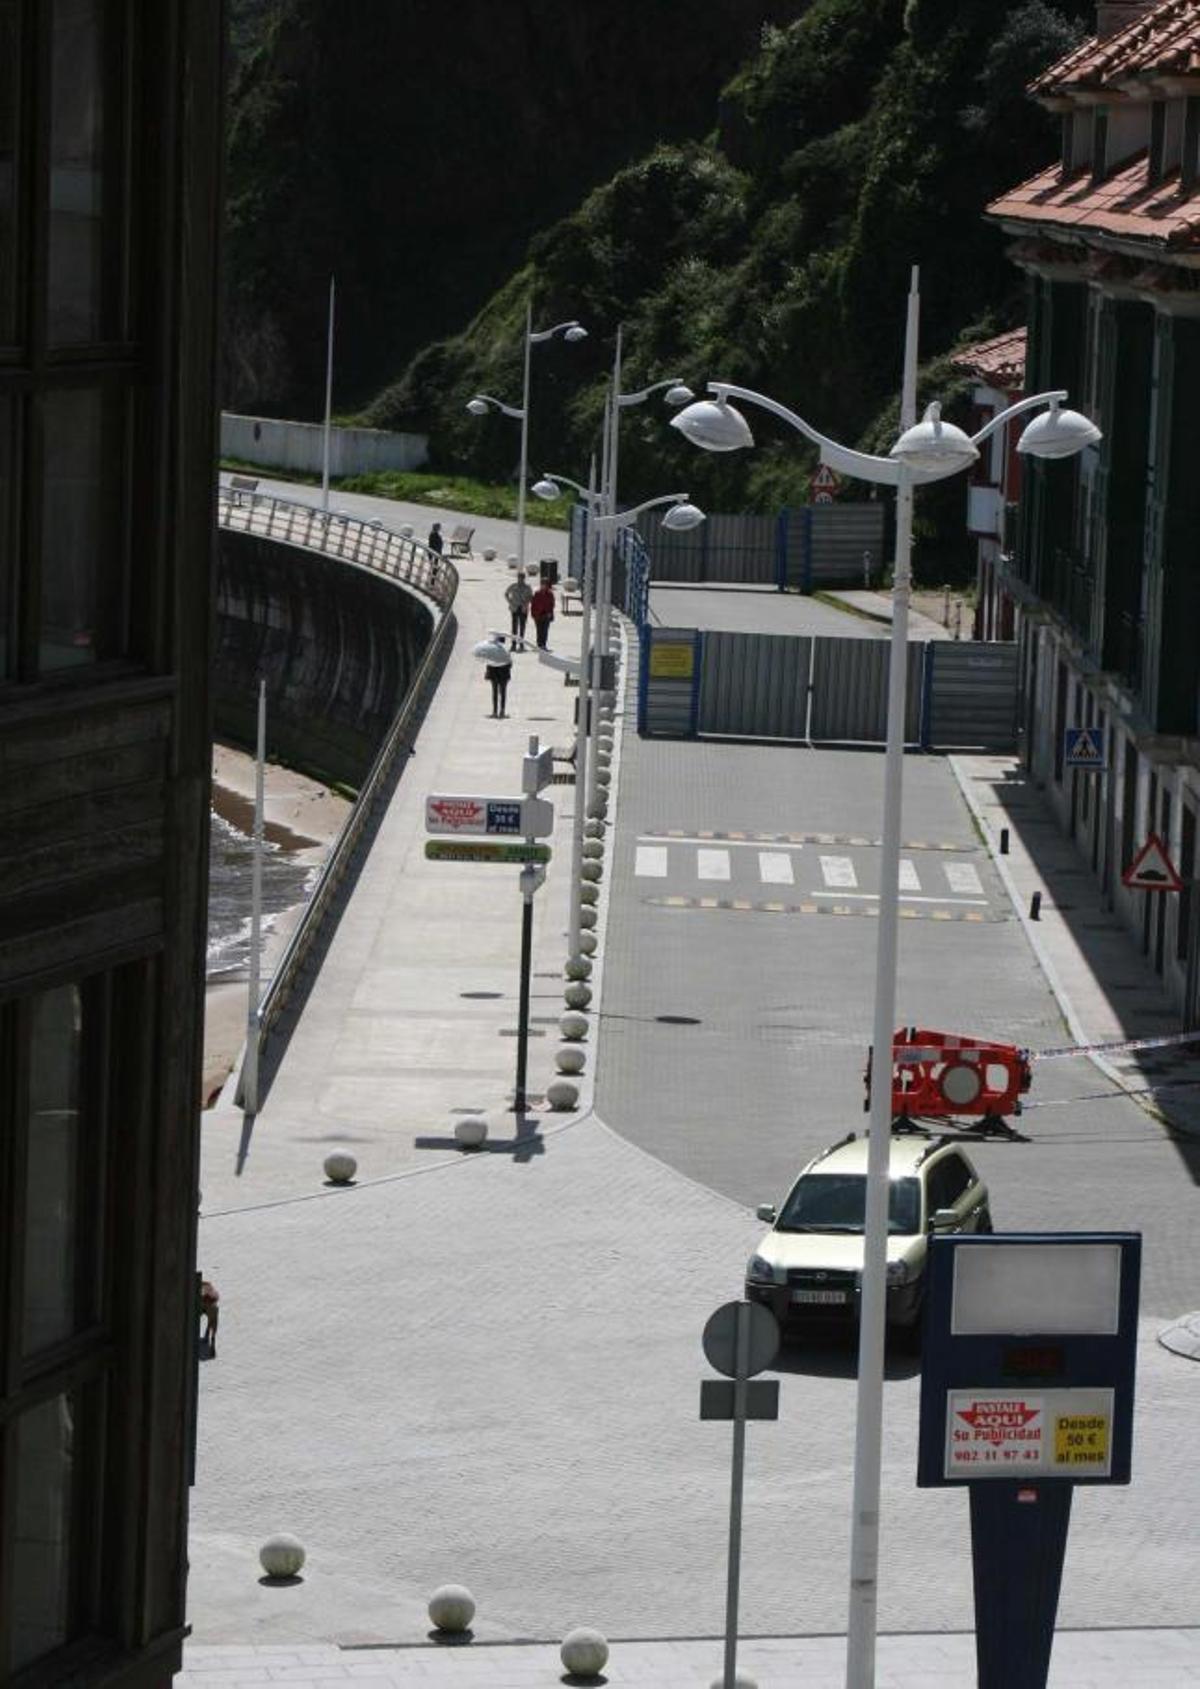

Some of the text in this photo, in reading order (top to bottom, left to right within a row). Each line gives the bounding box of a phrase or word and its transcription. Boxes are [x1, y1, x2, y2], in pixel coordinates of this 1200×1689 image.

[975, 1402, 1021, 1413] INSTALE
[974, 1414, 1025, 1427] AQUI
[1058, 1418, 1105, 1430] Desde
[953, 1427, 1041, 1441] Su Publicidad
[1066, 1434, 1097, 1446] 50 €
[954, 1451, 978, 1462] 902
[1056, 1451, 1105, 1463] al mes
